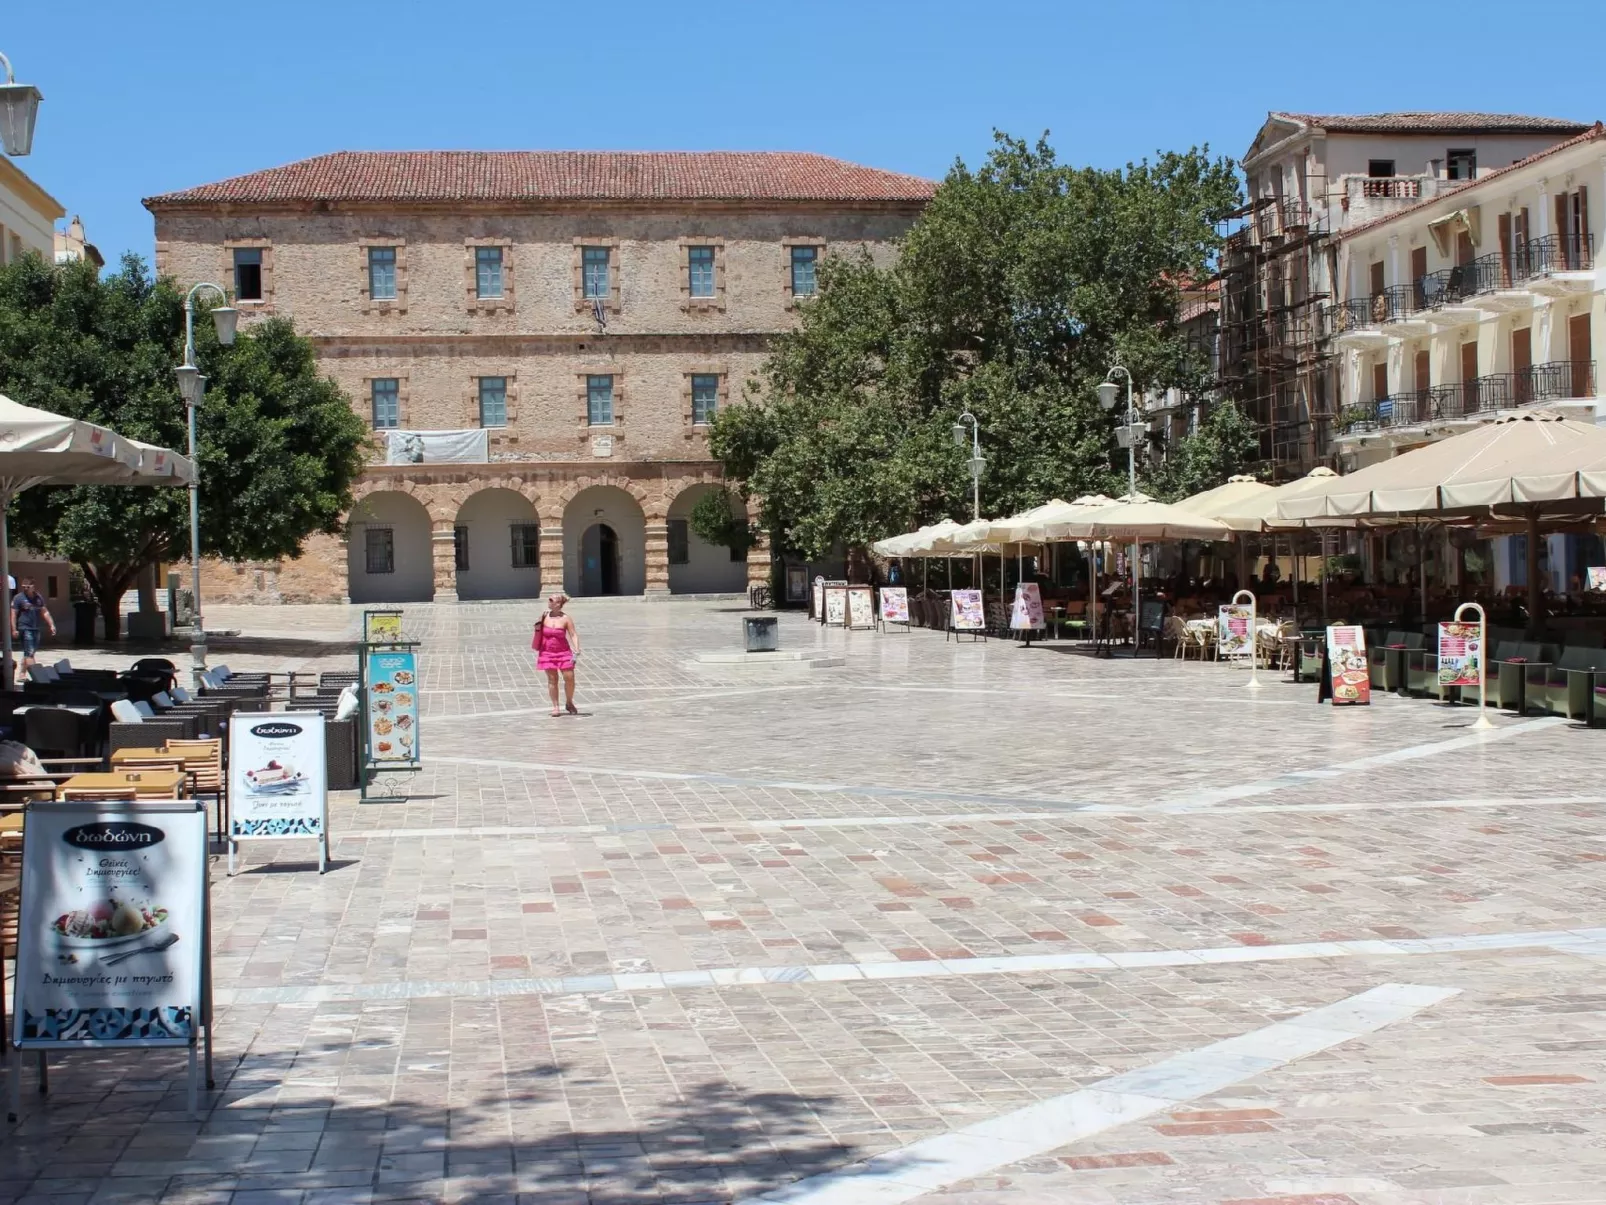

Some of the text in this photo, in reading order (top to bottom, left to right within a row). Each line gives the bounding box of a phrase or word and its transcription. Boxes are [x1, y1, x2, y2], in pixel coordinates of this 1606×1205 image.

[76, 829, 152, 842] δωδώνη
[41, 971, 174, 987] Δημιουργίες με παγωτό
